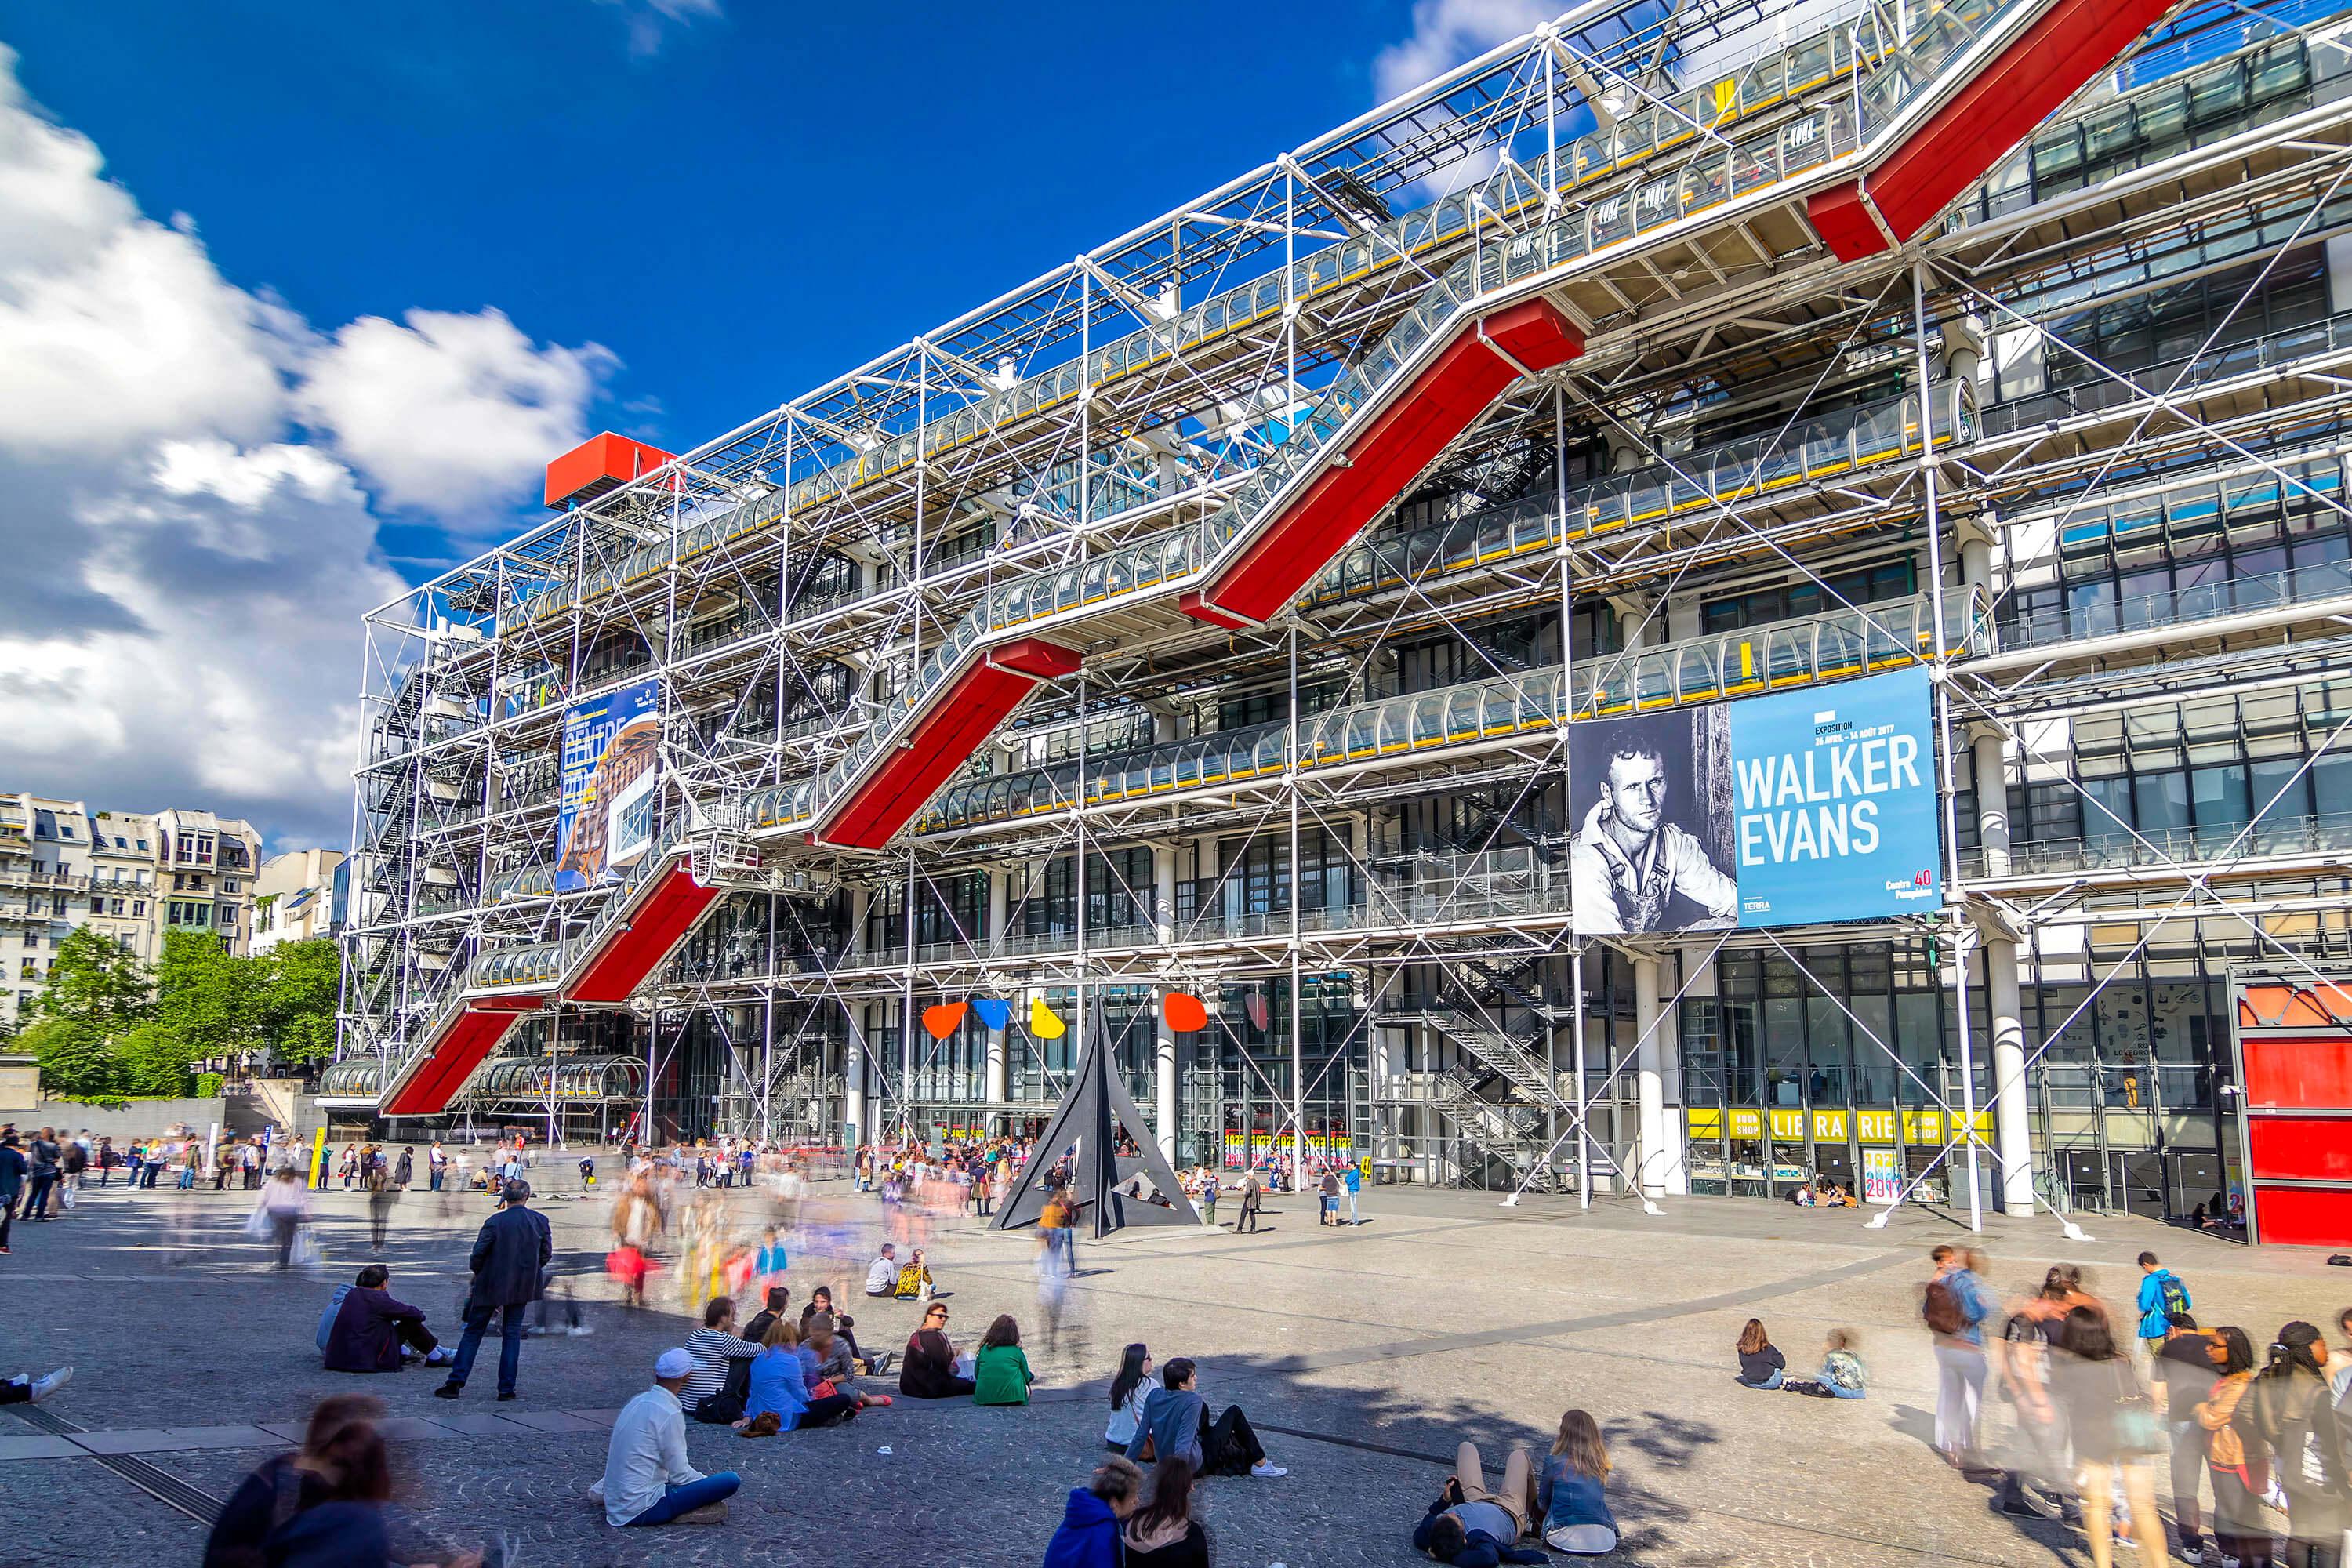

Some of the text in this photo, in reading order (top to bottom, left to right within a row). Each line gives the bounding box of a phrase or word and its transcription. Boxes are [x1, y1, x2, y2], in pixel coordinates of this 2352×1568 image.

[1815, 721, 1853, 735] EXPOSITION
[1736, 734, 1922, 810] WALKER
[1740, 800, 1880, 866] EVANS
[1915, 869, 1932, 886] 40
[1743, 901, 1771, 910] TERRA
[1737, 1115, 1758, 1123] BOOK
[1911, 1117, 1936, 1126] BOOK
[1737, 1126, 1759, 1134] SHOP
[1912, 1129, 1938, 1138] SHOP
